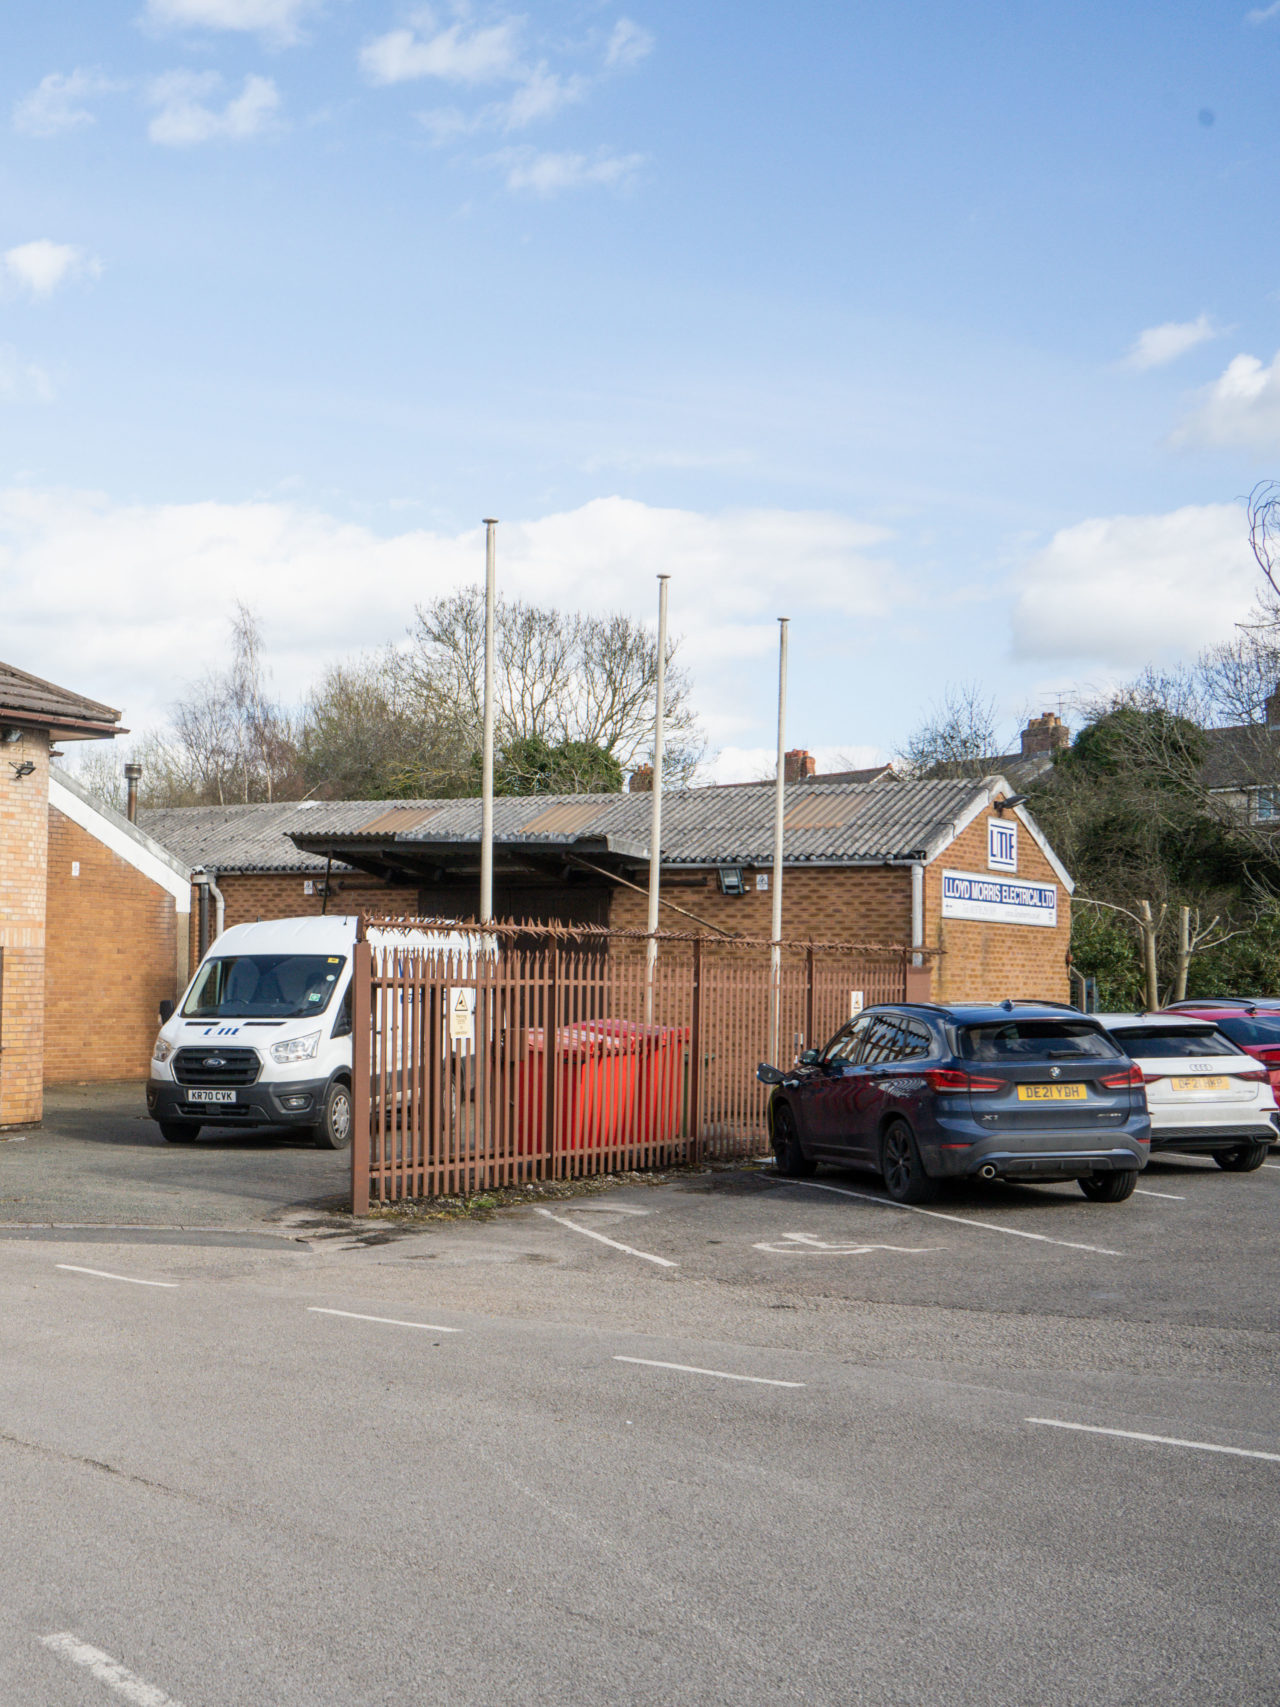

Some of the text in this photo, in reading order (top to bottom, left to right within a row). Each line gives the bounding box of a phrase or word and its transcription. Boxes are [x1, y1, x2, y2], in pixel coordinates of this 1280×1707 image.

[945, 878, 1054, 907] LLOYD MORRIS ELECTRICAL LTD
[191, 1091, 232, 1100] KR70 CVK
[1026, 1085, 1080, 1098] DE21 YDH
